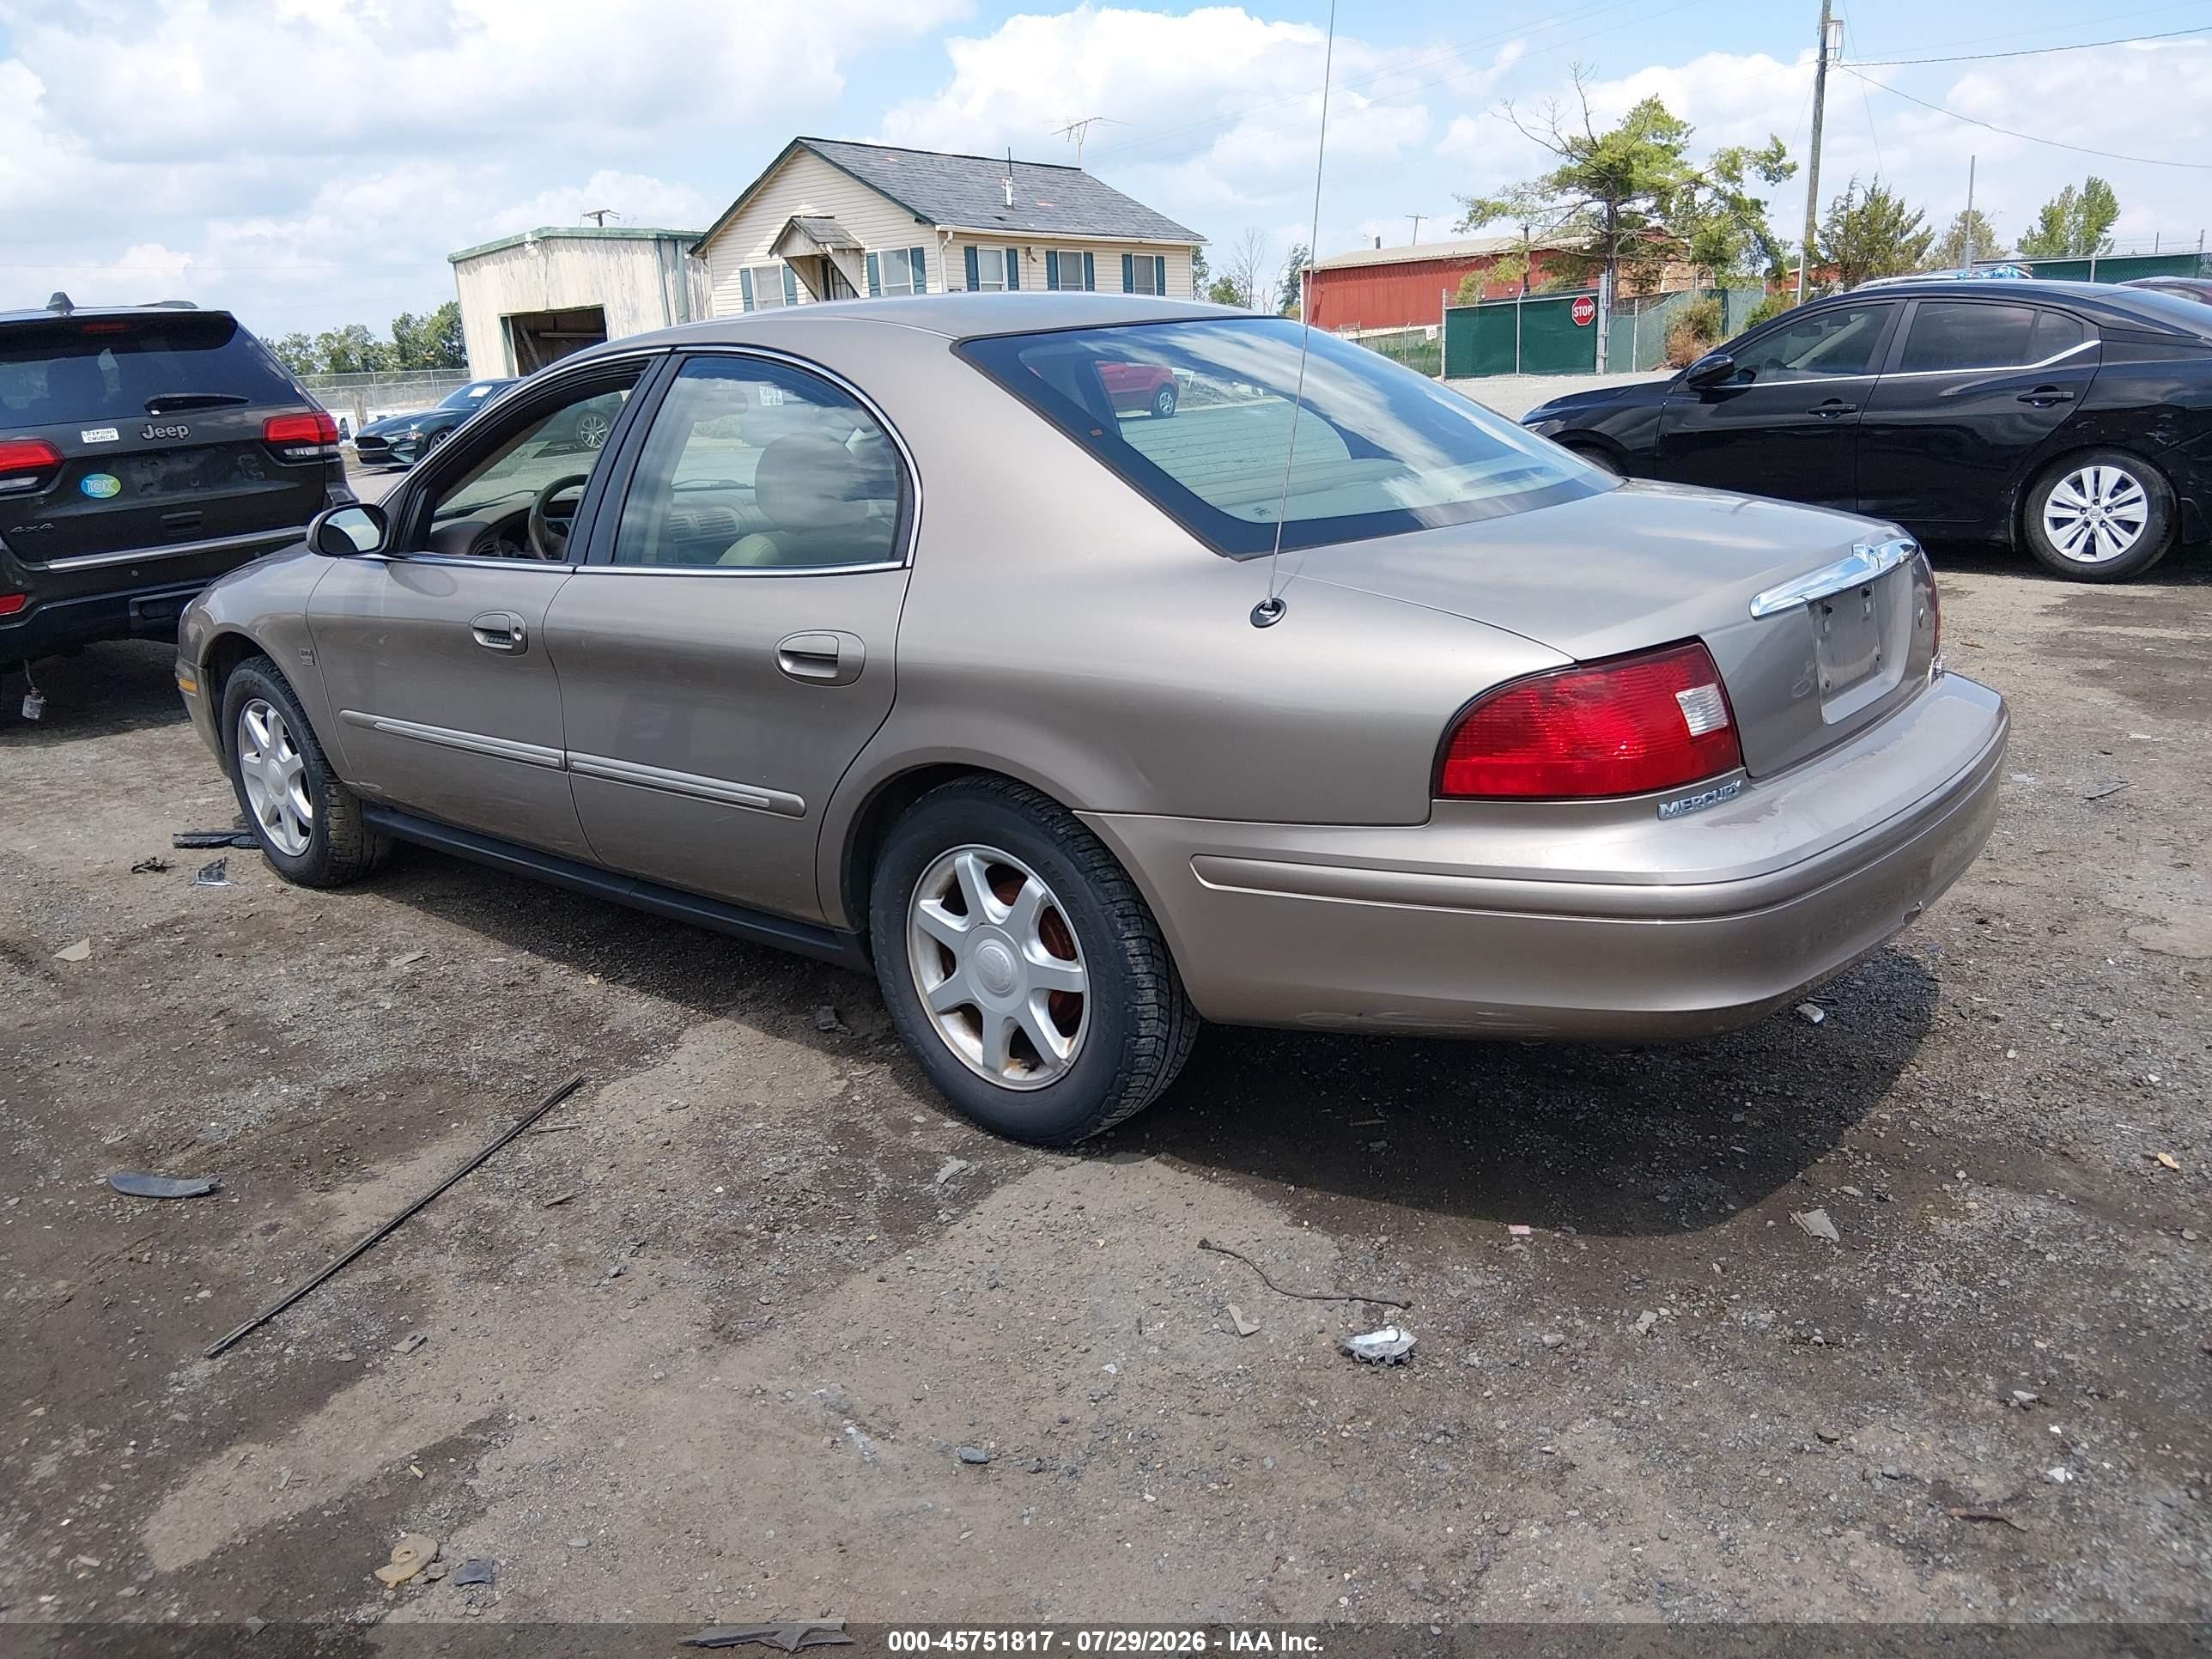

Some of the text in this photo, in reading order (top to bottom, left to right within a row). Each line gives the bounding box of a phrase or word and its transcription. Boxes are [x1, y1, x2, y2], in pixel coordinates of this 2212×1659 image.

[1574, 305, 1593, 318] STOP
[141, 423, 191, 441] Jeep
[1658, 780, 1742, 819] MERCURY
